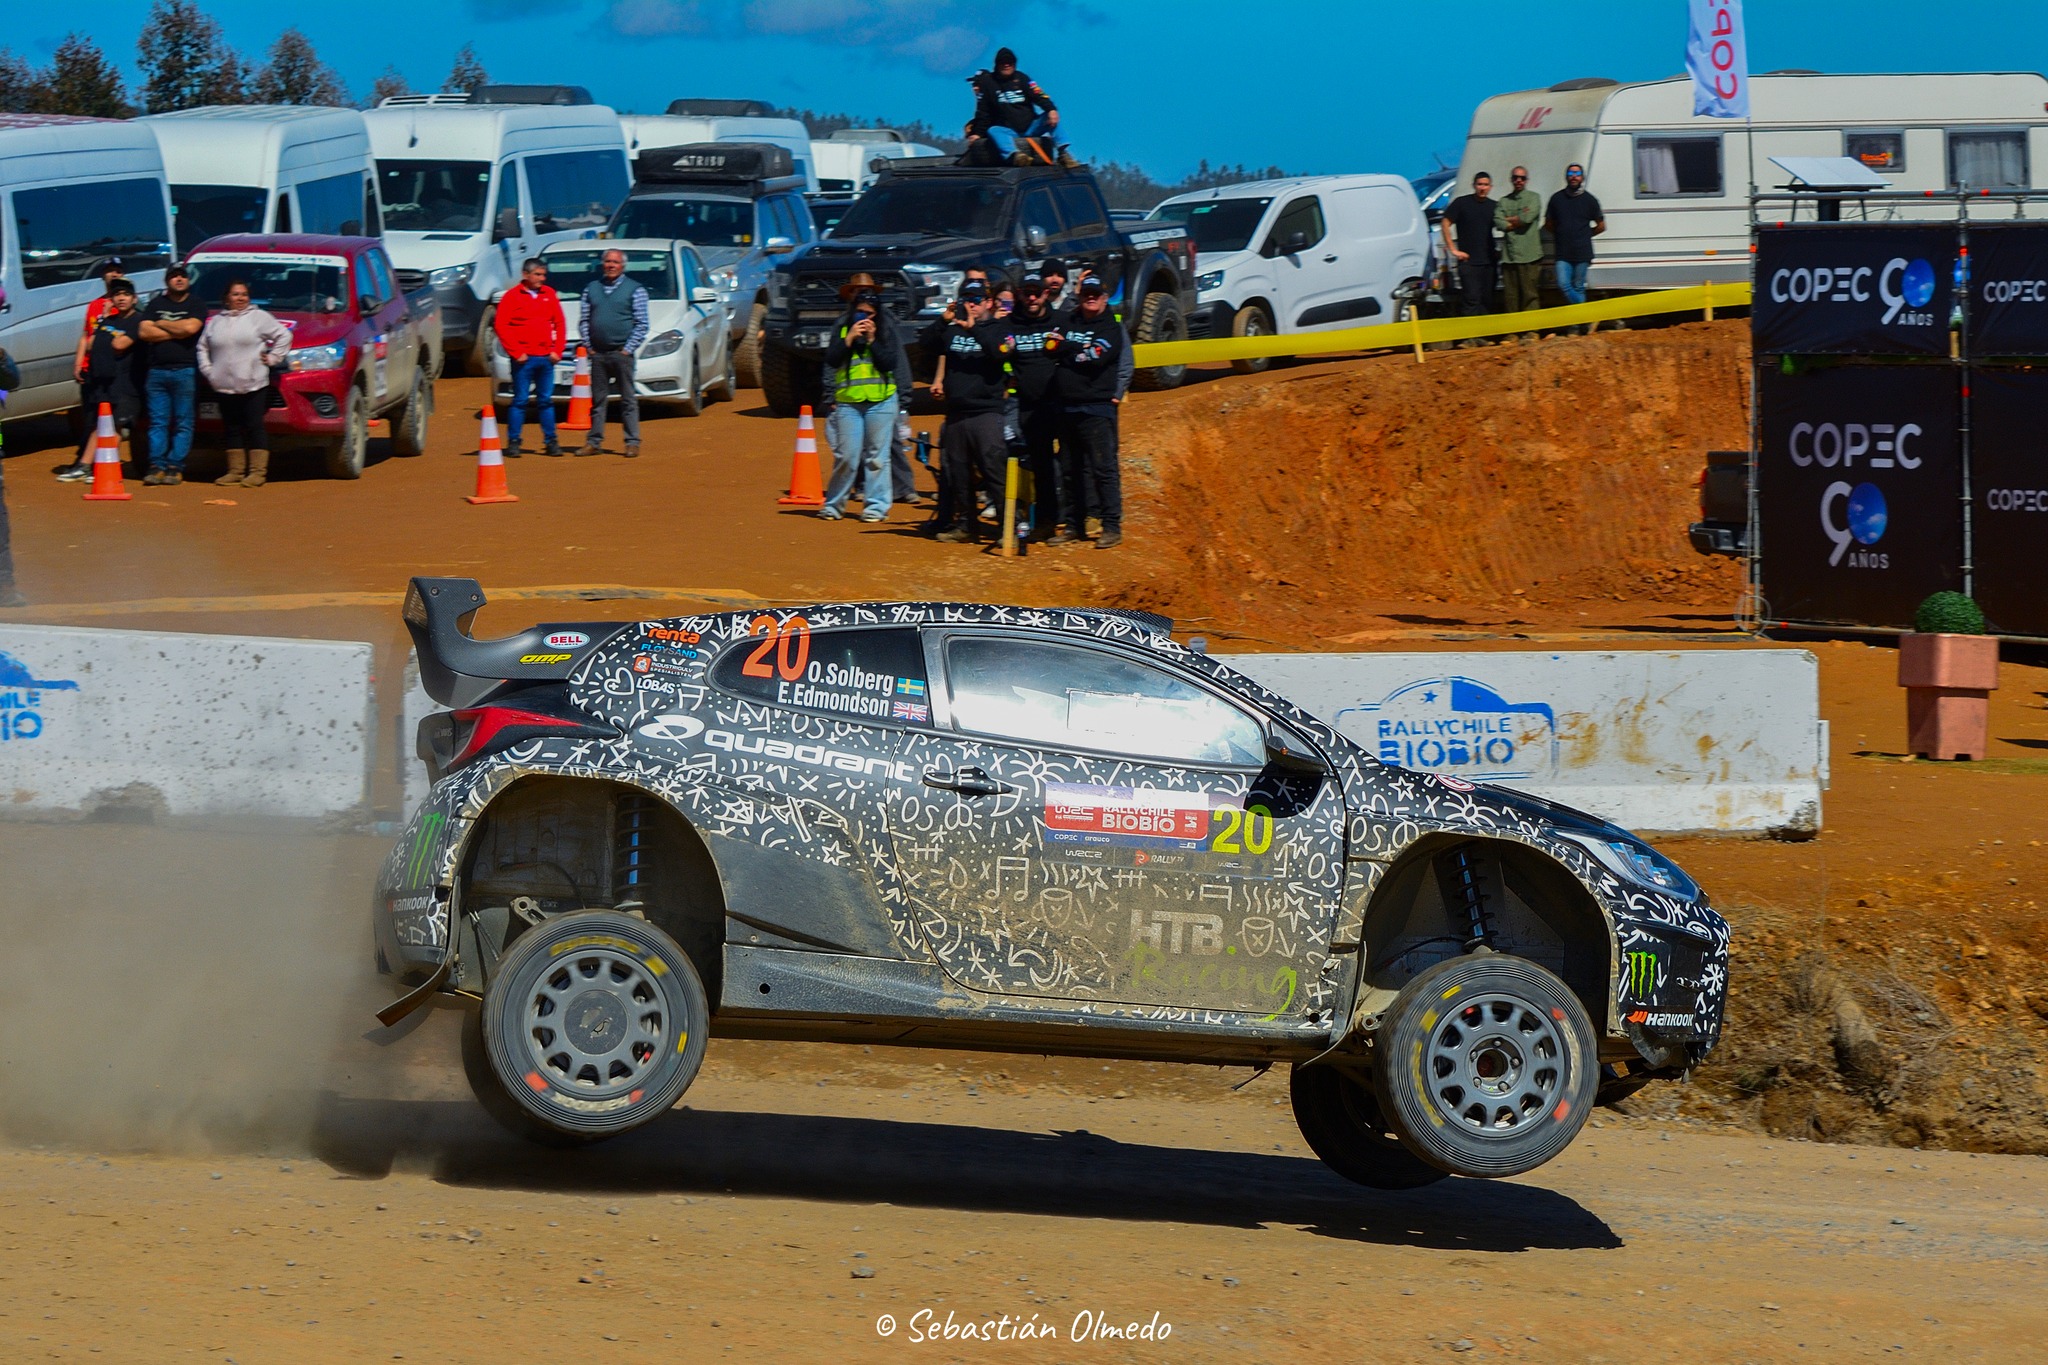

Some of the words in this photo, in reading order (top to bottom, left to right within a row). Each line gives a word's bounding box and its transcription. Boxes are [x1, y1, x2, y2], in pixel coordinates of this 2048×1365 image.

[1771, 267, 1872, 303] COPEC
[1983, 280, 2047, 302] COPEC
[1897, 311, 1934, 326] AÑOS
[1789, 422, 1922, 470] COPEC
[1987, 488, 2048, 512] COPEC
[1848, 549, 1889, 569] AÑOS
[648, 628, 700, 644] renta
[742, 615, 811, 682] 20
[808, 661, 894, 697] O.Solberg
[777, 681, 890, 717] E.Edmondson
[1378, 717, 1513, 739] RALLYCHILE
[704, 729, 915, 783] quadrant
[1055, 806, 1094, 816] WRC
[1102, 806, 1176, 817] RALLYCHILE
[1054, 833, 1078, 841] COPEC
[1084, 835, 1110, 843] arauco
[1212, 803, 1273, 855] 20
